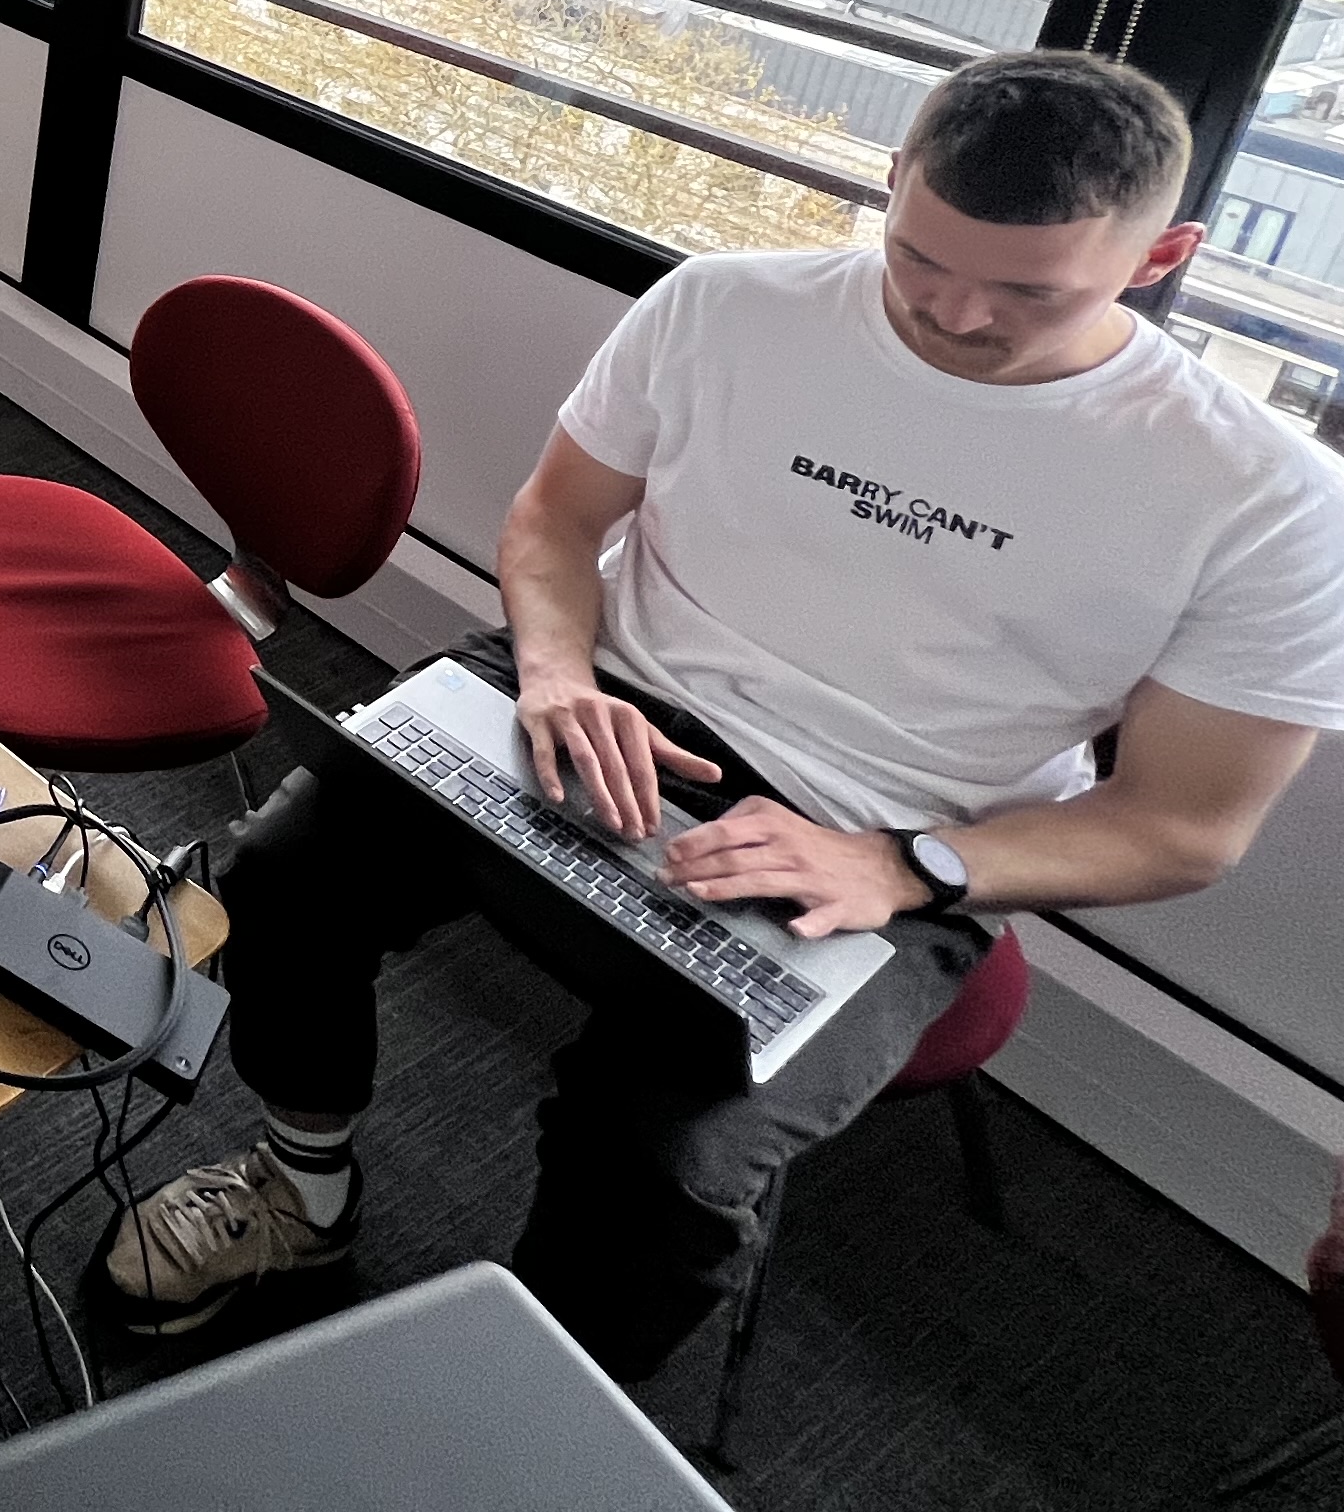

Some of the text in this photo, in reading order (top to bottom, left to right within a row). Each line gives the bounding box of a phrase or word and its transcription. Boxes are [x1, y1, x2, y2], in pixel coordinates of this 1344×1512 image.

[790, 454, 1014, 551] BARRY CAN'T
[850, 499, 935, 545] SWIM
